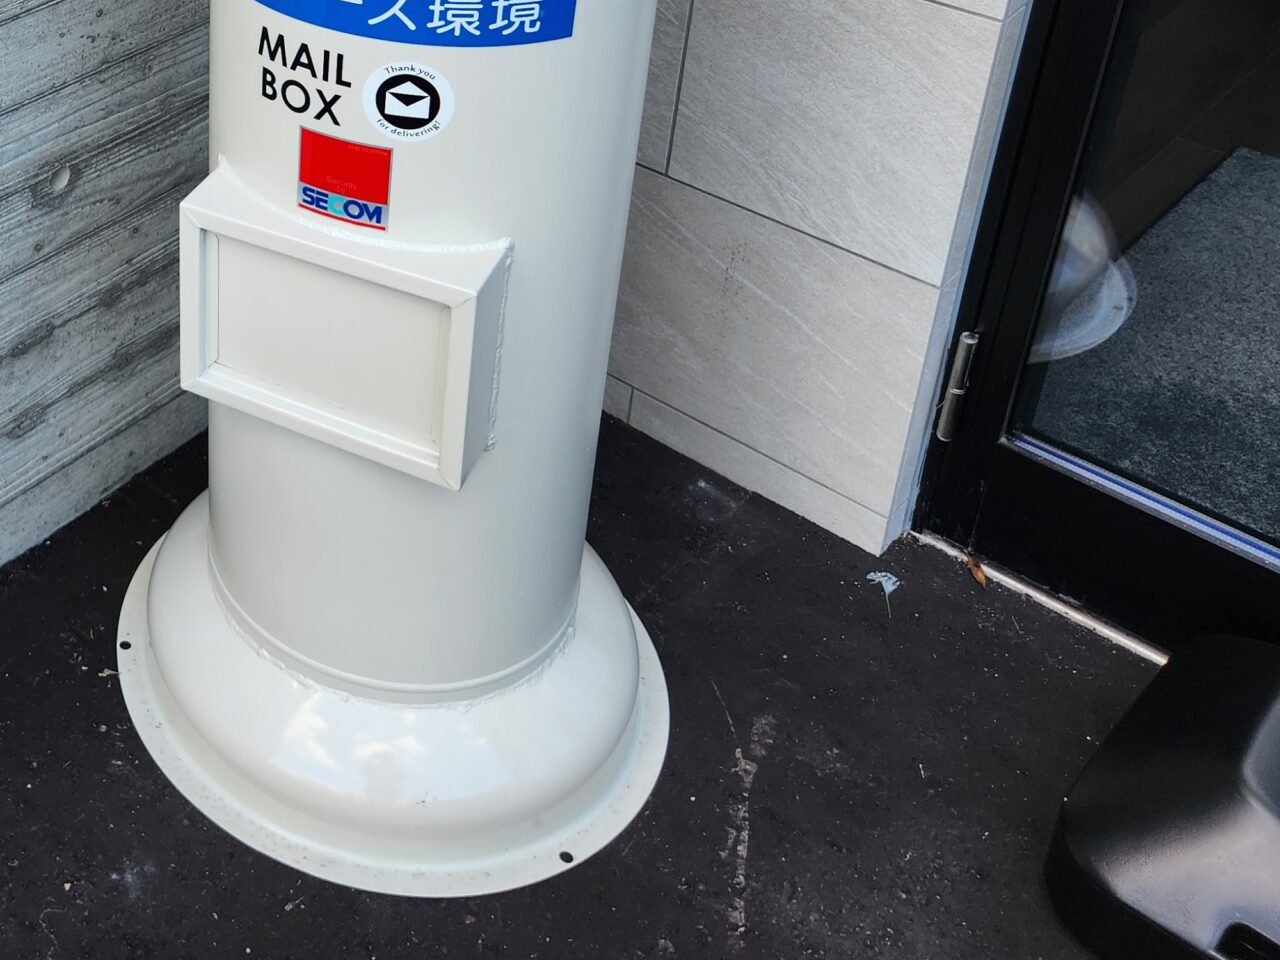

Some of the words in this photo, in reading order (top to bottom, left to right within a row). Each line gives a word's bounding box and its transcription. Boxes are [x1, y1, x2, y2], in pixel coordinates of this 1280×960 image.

[258, 25, 352, 88] MAIL
[384, 64, 417, 75] Thank
[416, 68, 436, 80] you
[261, 66, 342, 127] BOX
[376, 118, 389, 130] for
[390, 120, 441, 137] delivering!
[326, 175, 358, 191] Security
[302, 185, 383, 224] SECOM
